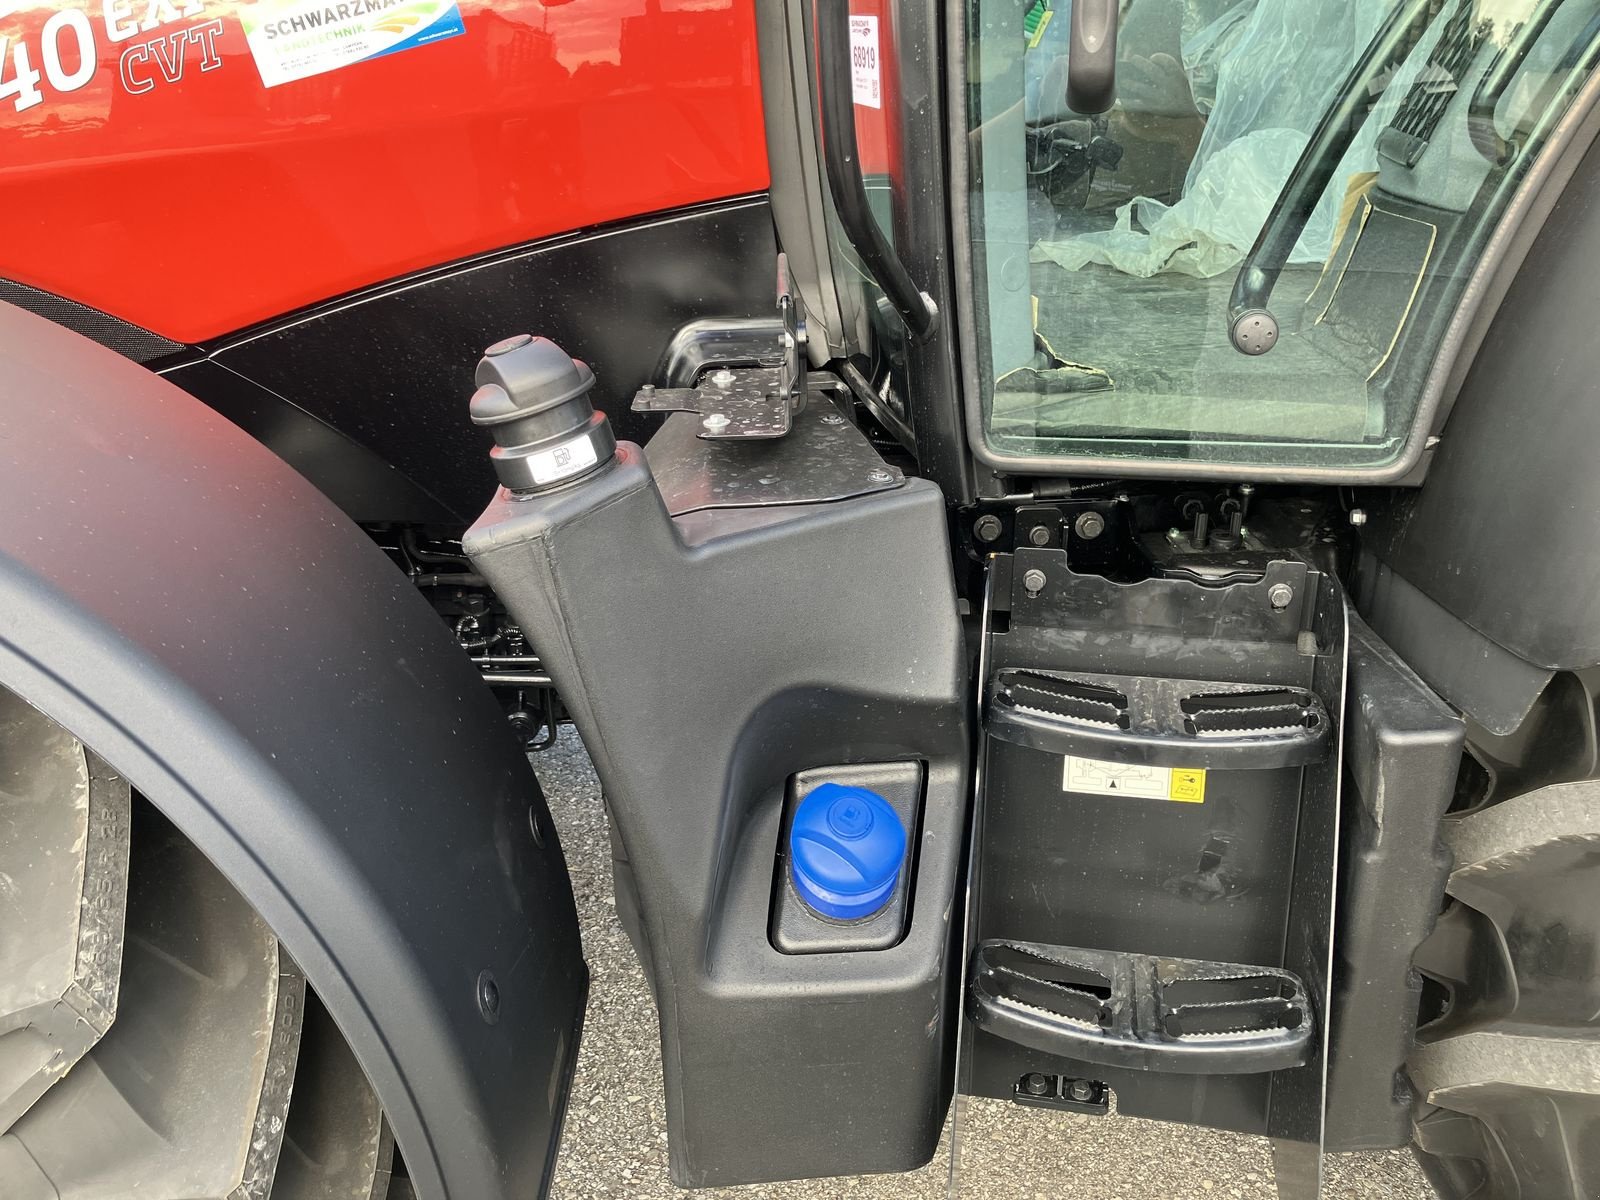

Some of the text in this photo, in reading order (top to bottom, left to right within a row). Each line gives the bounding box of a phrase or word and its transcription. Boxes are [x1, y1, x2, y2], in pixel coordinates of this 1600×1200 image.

[264, 0, 404, 40] SCHWARZMA
[0, 8, 97, 112] 40
[120, 18, 223, 94] CVT
[853, 45, 876, 70] 68919
